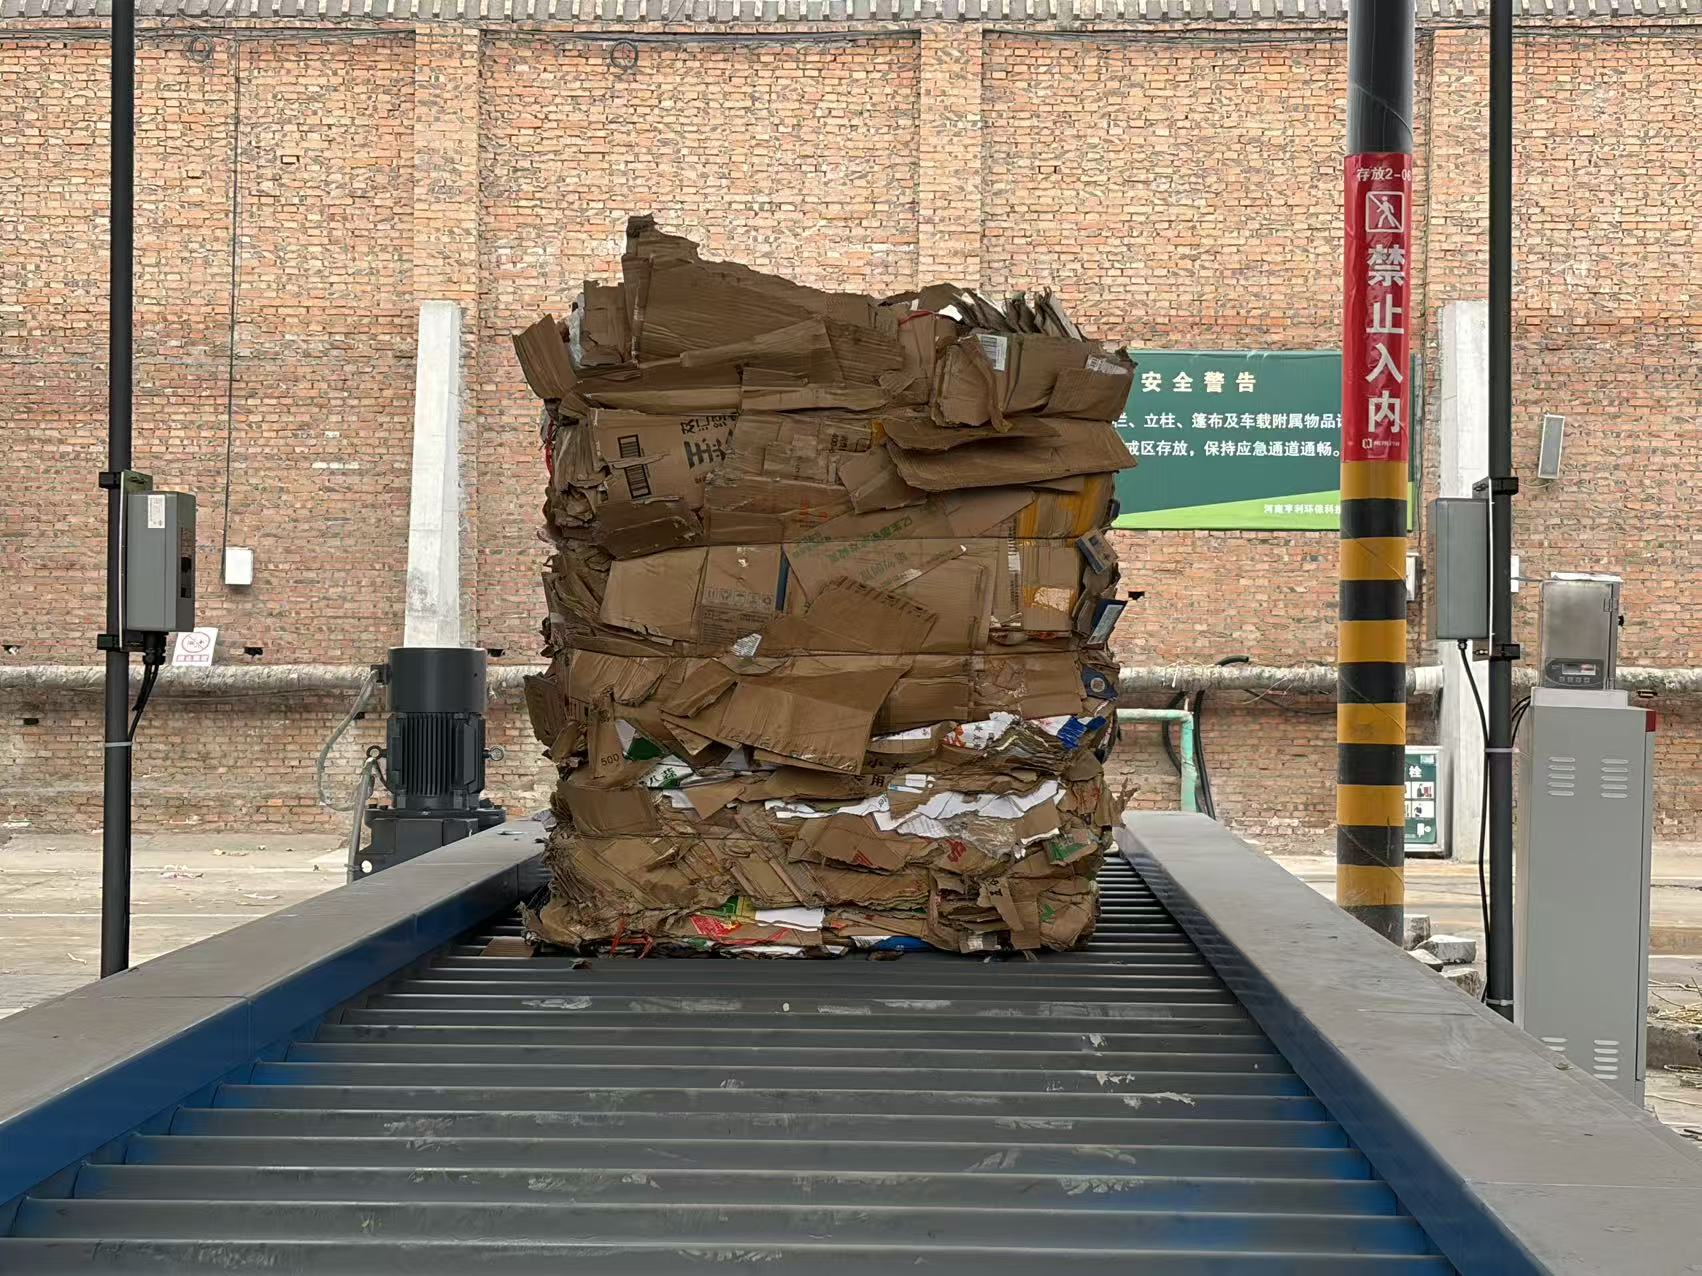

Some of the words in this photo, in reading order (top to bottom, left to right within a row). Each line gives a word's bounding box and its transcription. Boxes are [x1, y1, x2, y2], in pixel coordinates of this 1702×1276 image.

[1365, 244, 1406, 433] 禁止入内
[1141, 371, 1256, 393] 安全警告
[1112, 412, 1342, 429] 栏、立柱、篷布及车载附属物品
[600, 753, 620, 766] 500
